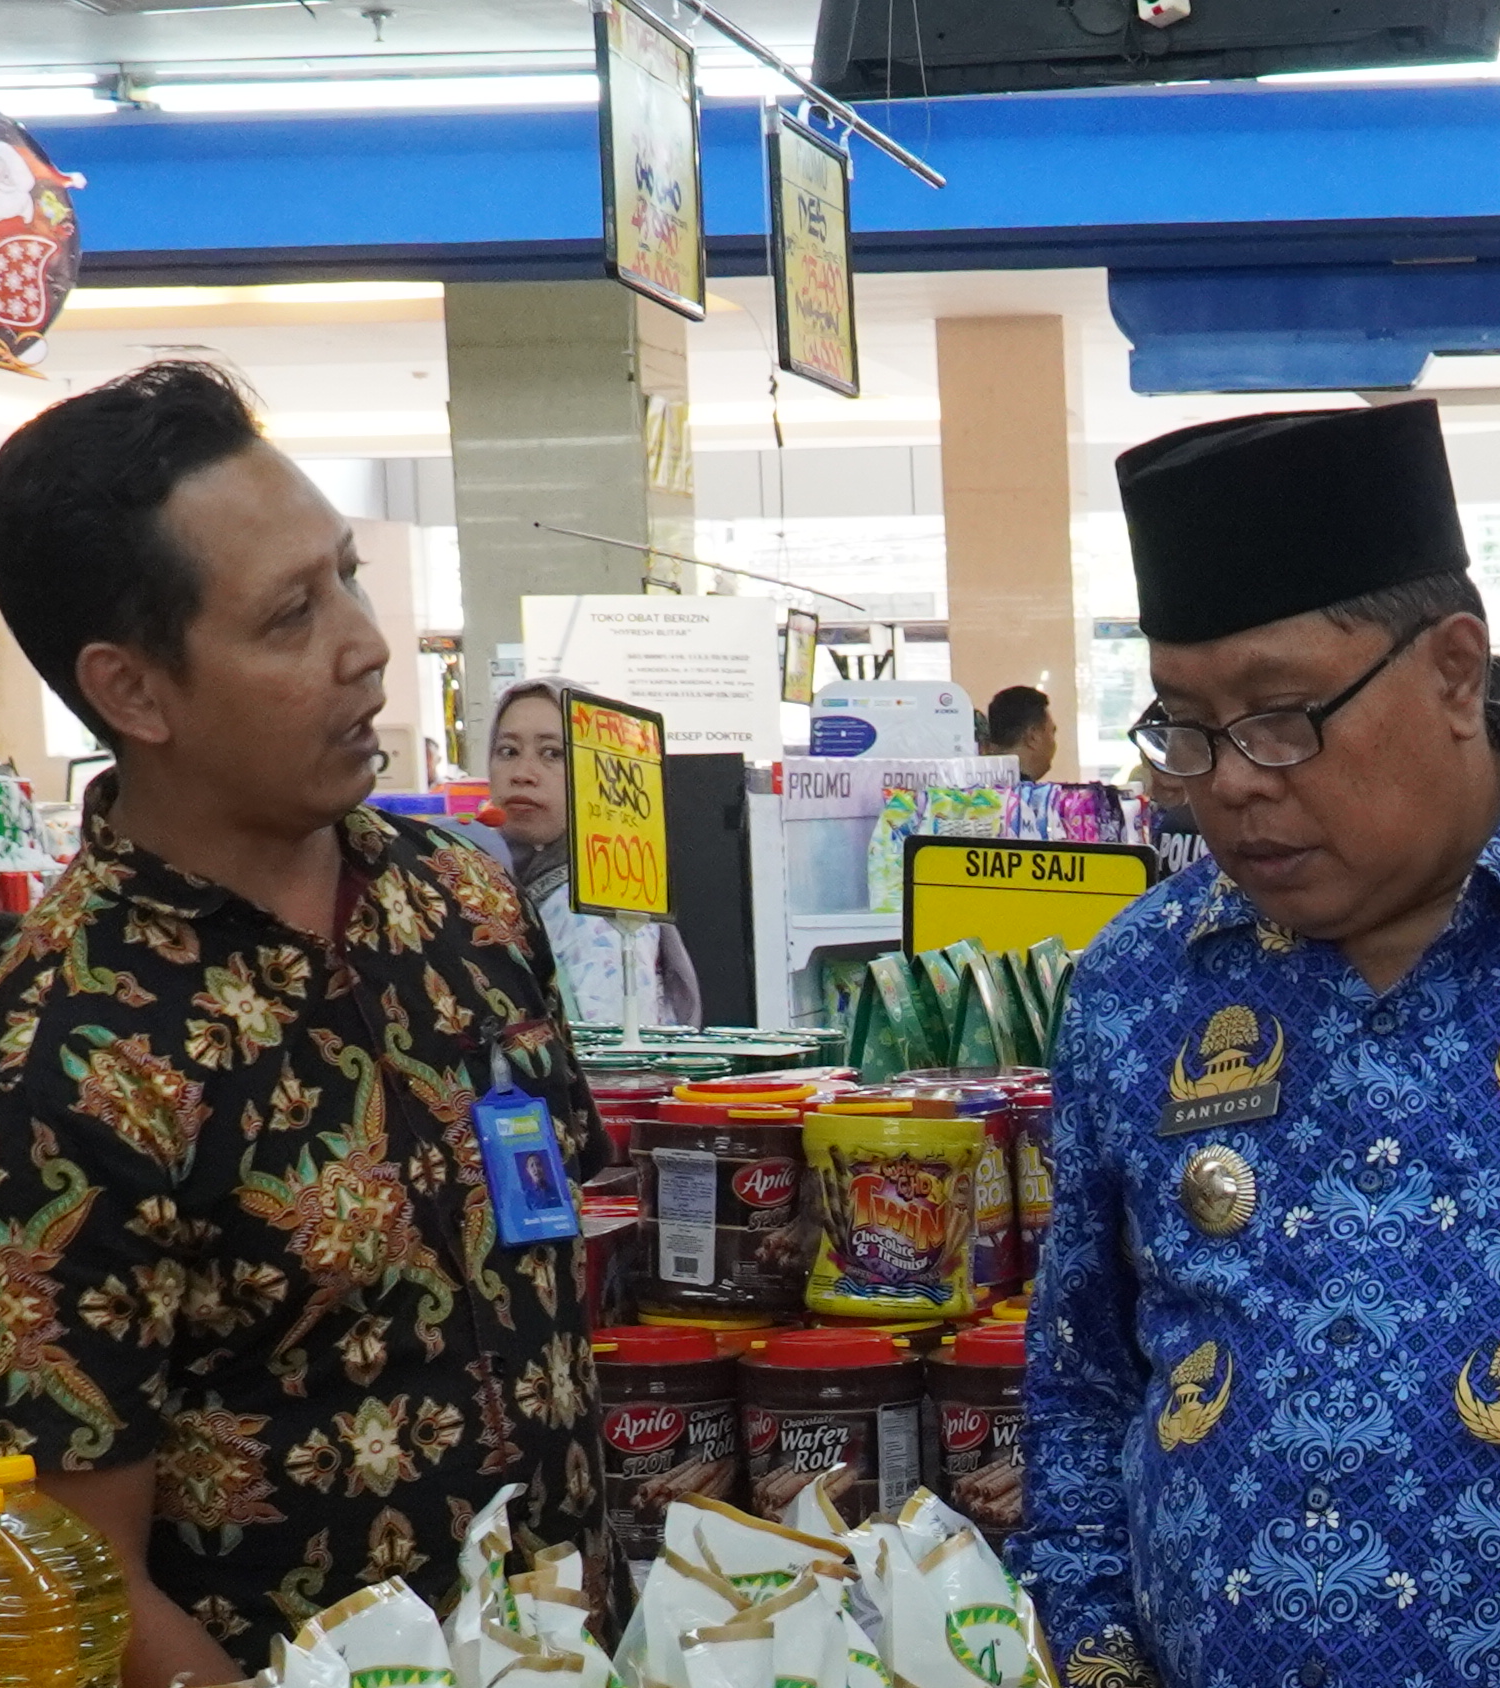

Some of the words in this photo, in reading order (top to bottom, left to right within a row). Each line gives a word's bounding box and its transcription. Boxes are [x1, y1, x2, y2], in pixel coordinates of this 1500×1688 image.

[590, 613, 623, 623] TOKO
[627, 613, 660, 623] OBAT
[663, 613, 710, 623] BERIZIN
[667, 732, 702, 741] RESEP
[705, 732, 753, 742] DOKTER
[788, 773, 851, 800] PROMO
[966, 850, 1022, 878] SIAP
[1032, 854, 1086, 883] SAJI
[1174, 1094, 1262, 1123] SANTOSO
[742, 1168, 796, 1200] Apilo
[852, 1230, 915, 1258] Chocolate
[612, 1406, 675, 1442] Apilo
[780, 1425, 850, 1453] Wafer
[794, 1447, 843, 1475] Roll
